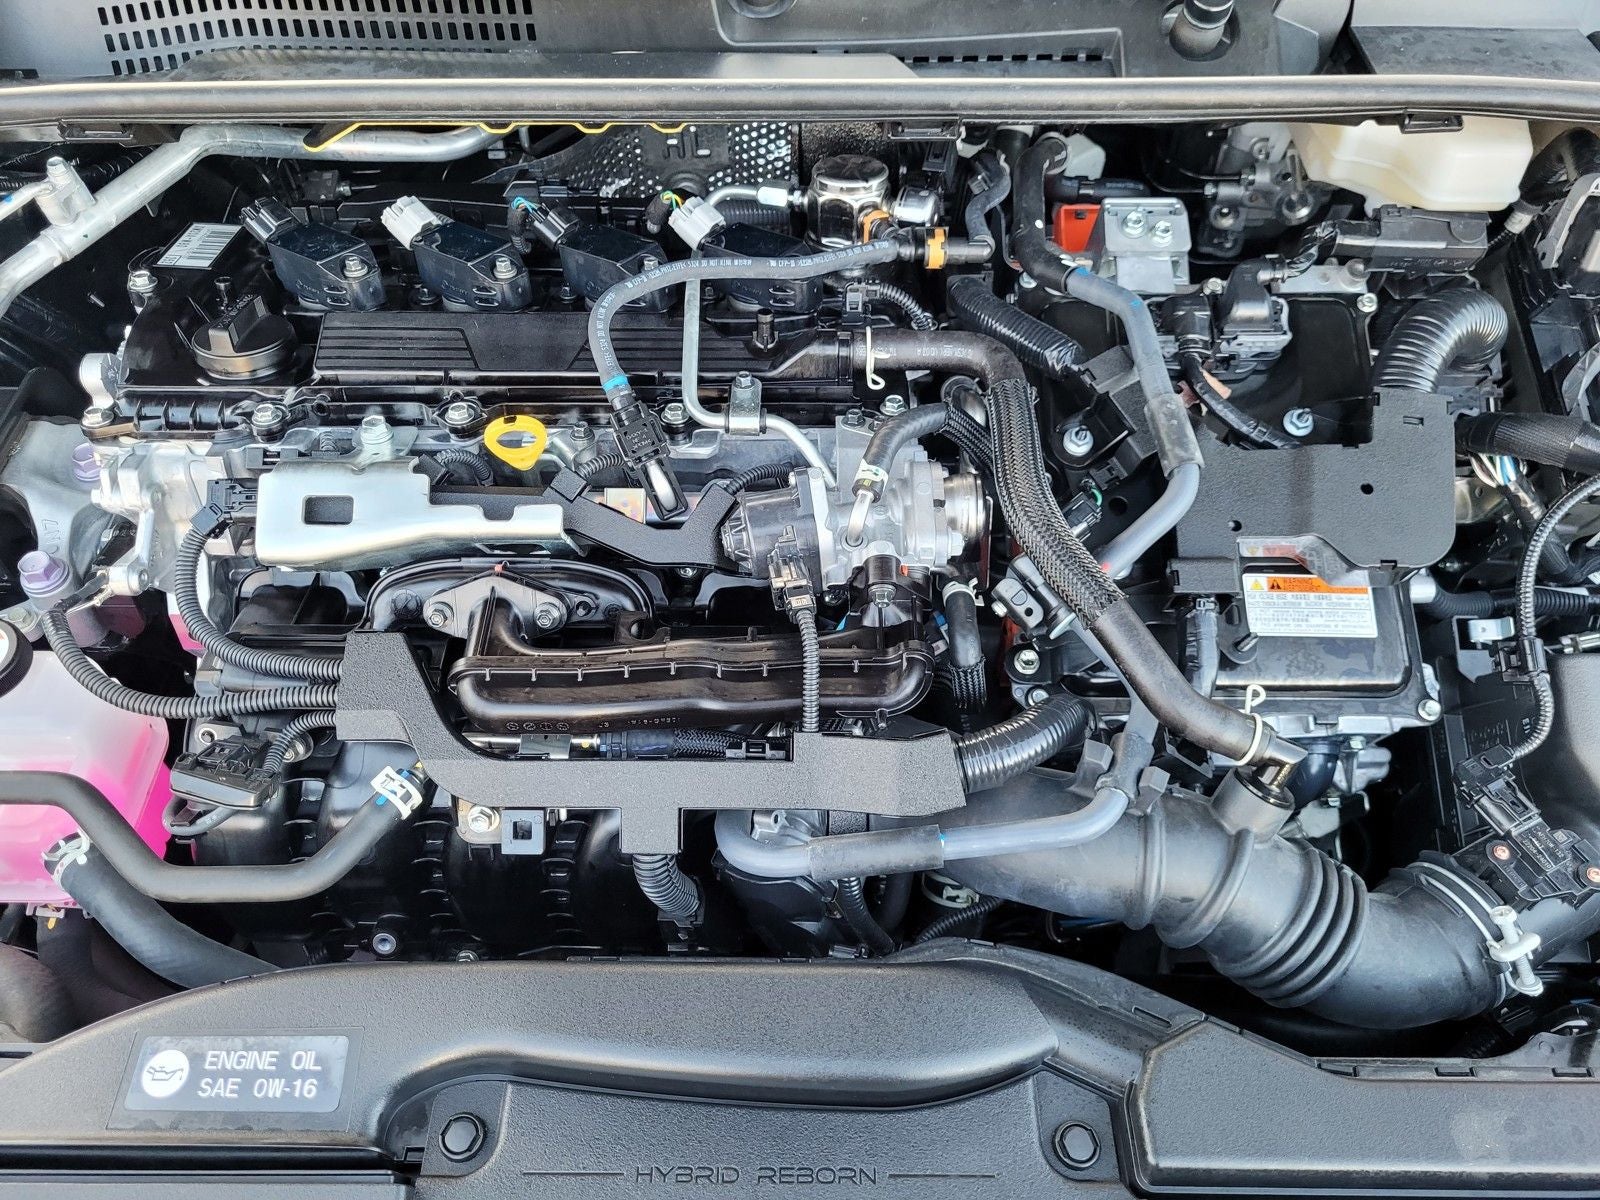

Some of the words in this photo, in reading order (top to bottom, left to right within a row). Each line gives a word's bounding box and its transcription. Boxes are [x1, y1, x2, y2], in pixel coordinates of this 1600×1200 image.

[204, 1050, 279, 1070] ENGINE
[291, 1050, 322, 1070] OIL
[197, 1078, 242, 1098] SAE
[253, 1078, 318, 1098] 0W-16
[636, 1166, 740, 1184] HYBRID
[757, 1166, 877, 1185] REBORN
